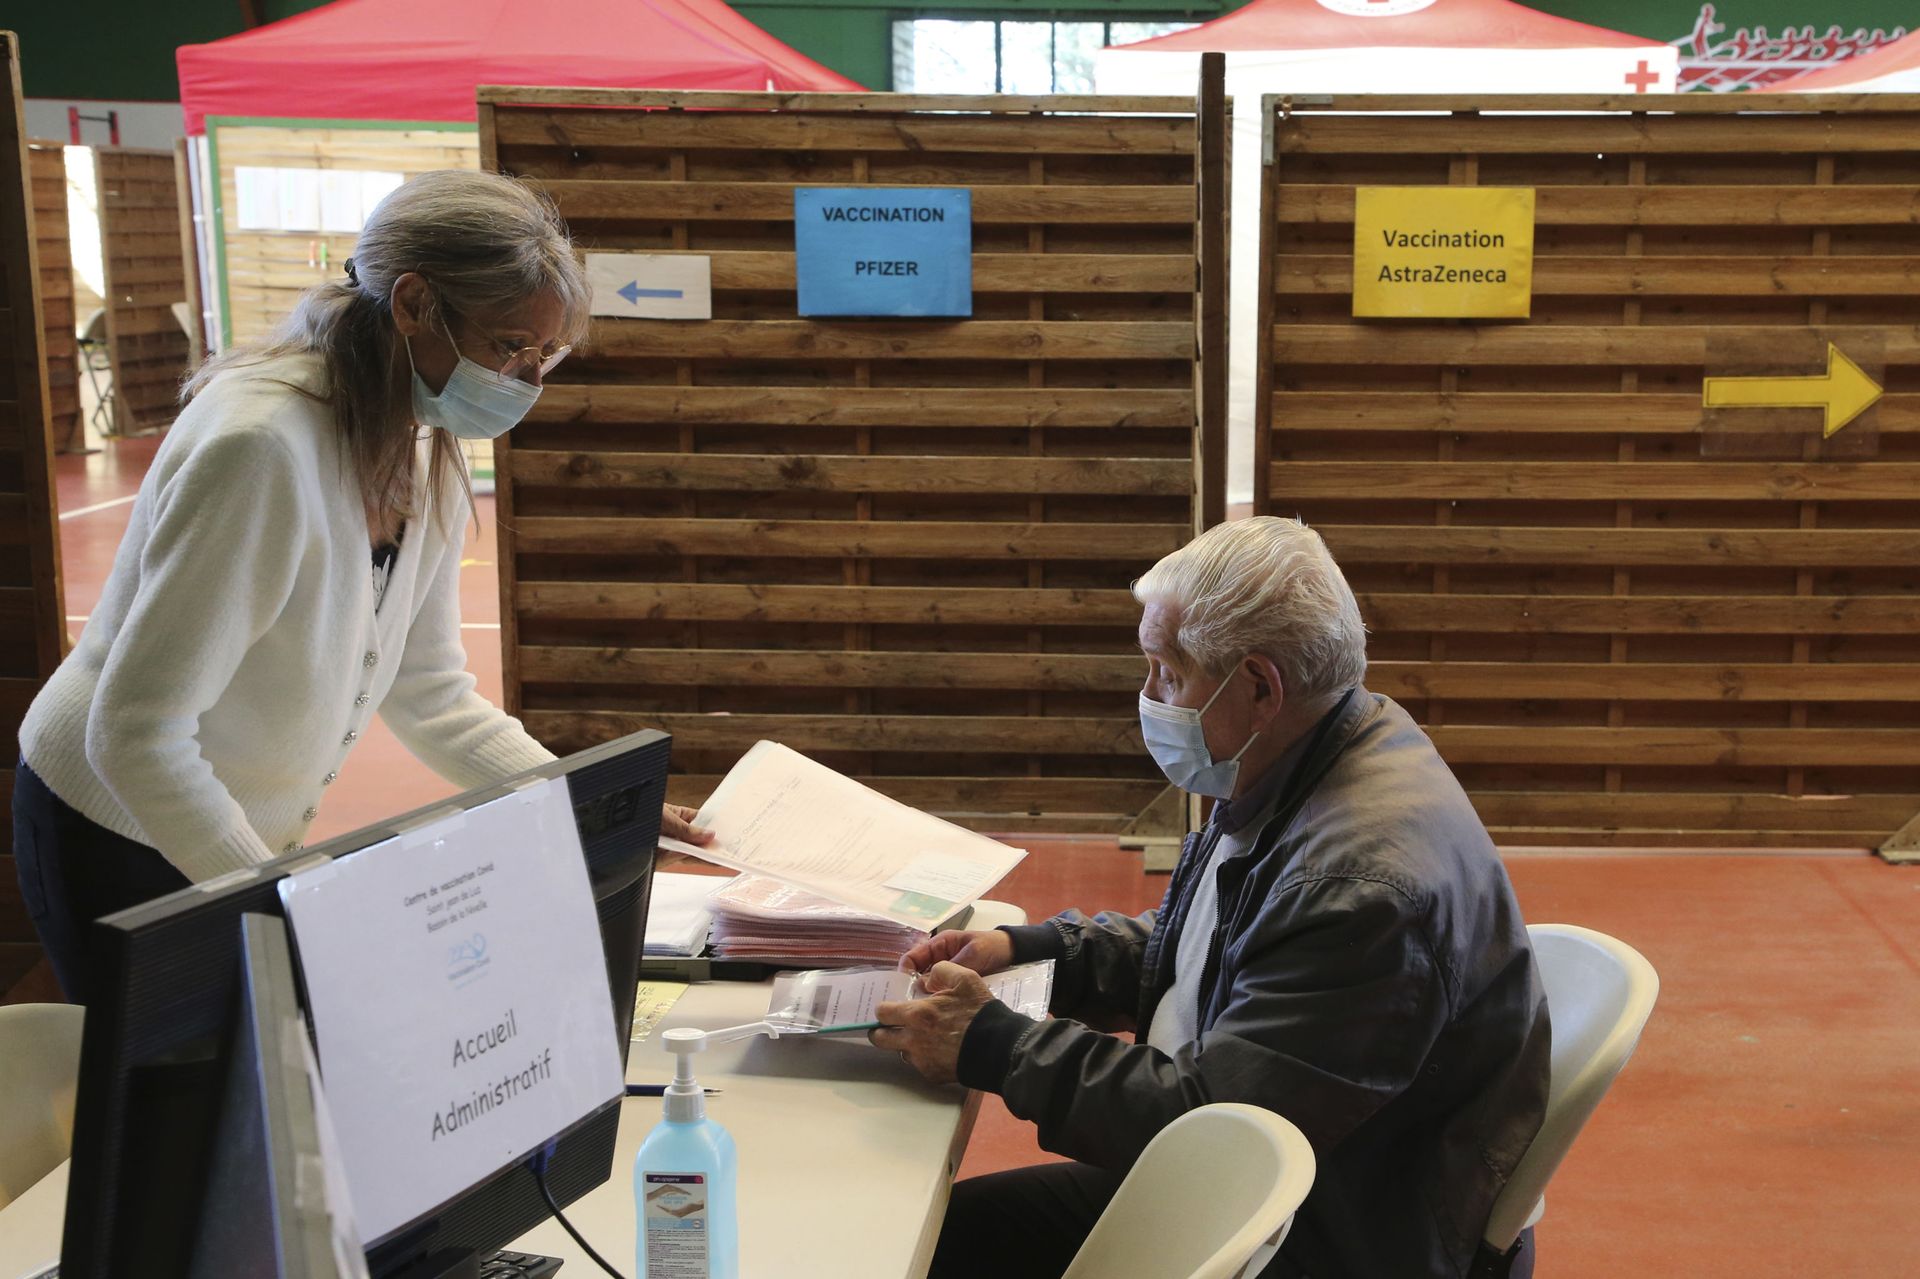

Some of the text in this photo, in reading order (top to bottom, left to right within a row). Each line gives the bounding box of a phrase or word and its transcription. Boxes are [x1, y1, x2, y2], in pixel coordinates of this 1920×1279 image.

[822, 207, 944, 222] VACCINATION
[1383, 229, 1504, 248] Vaccination
[855, 261, 919, 276] PFIZER
[1378, 265, 1506, 283] AstraZeneca
[403, 892, 428, 907] Centre
[429, 885, 438, 896] de
[440, 871, 475, 891] vaccination
[453, 1008, 517, 1068] Accueil
[432, 1047, 551, 1142] Administratif
